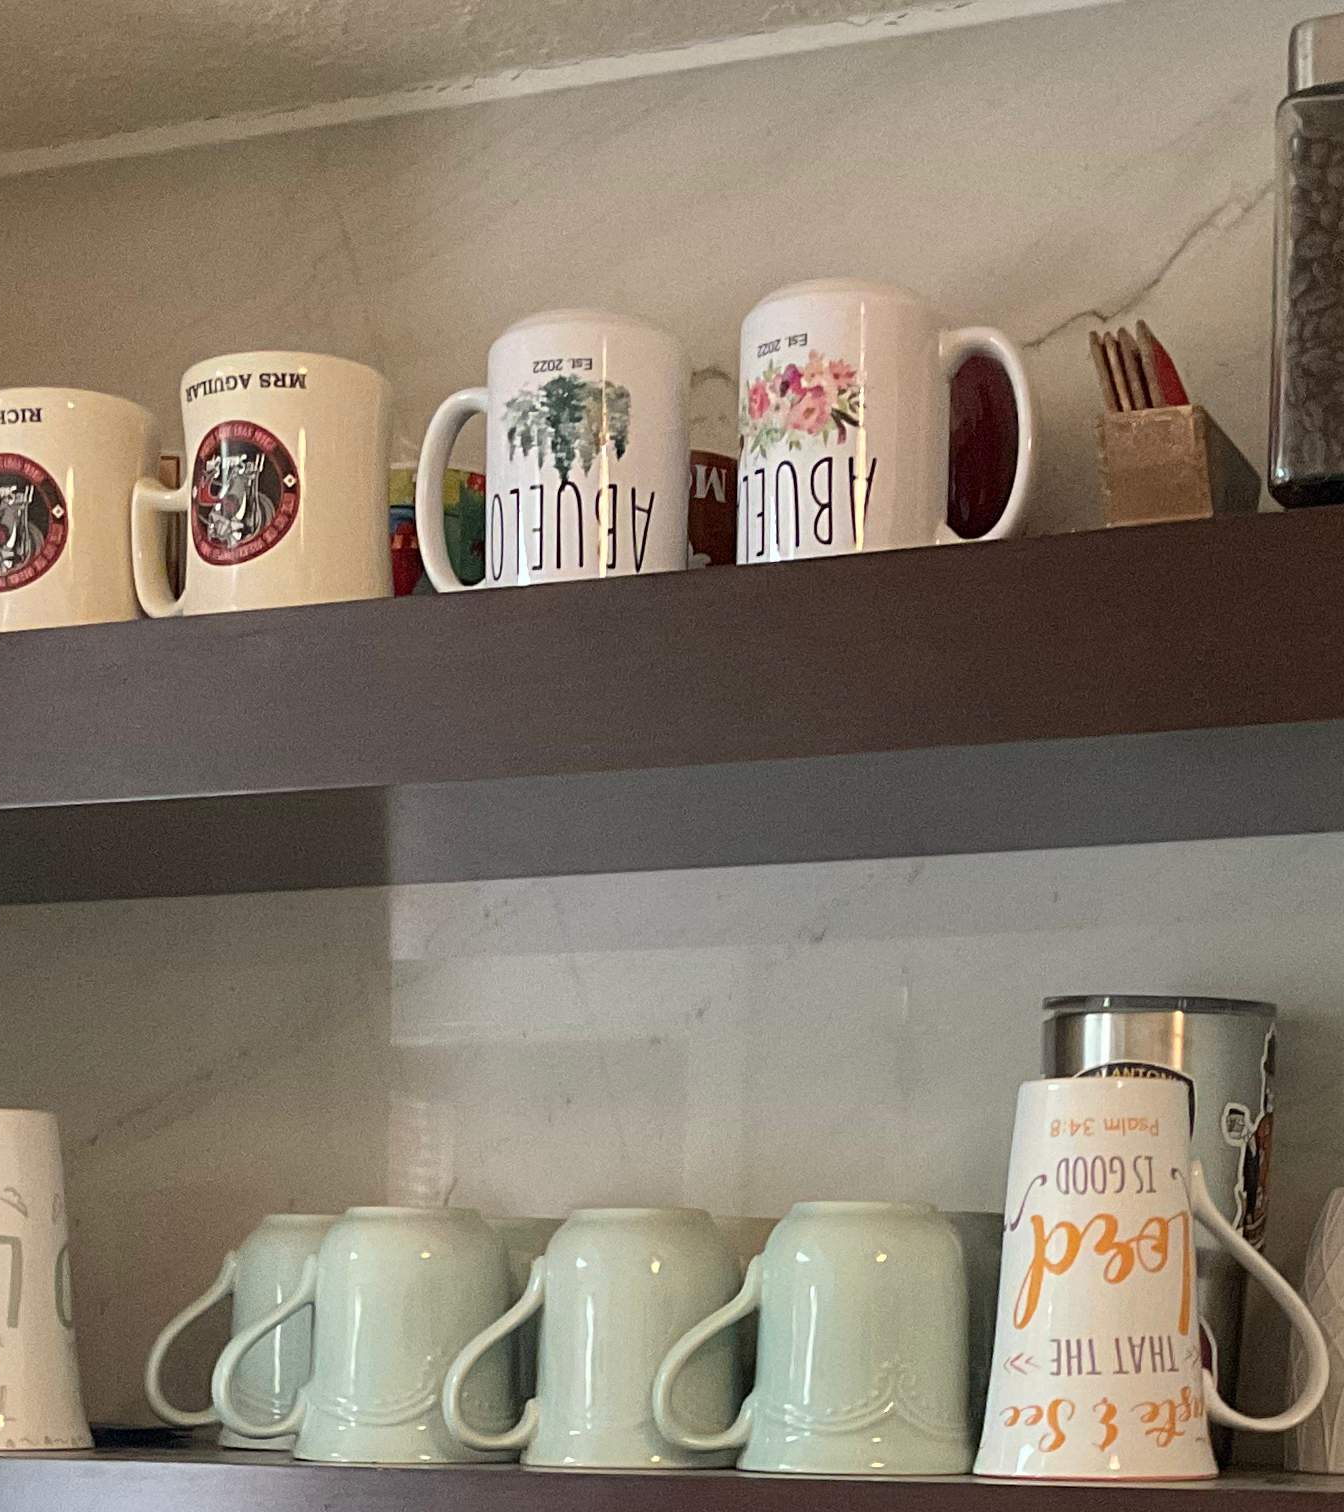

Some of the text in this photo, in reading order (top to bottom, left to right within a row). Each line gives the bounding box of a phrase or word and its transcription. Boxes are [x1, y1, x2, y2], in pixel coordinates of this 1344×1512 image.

[532, 357, 593, 374] Est. 2022
[185, 372, 308, 403] MRS AGUILAR
[737, 456, 877, 564] ABUEL
[491, 481, 657, 582] ABUELO
[1050, 1117, 1160, 1138] Psalm 34:8
[1056, 1155, 1158, 1195] IS GOOD
[1049, 1335, 1180, 1377] THAT THE
[999, 1397, 1076, 1453] See
[1091, 1396, 1120, 1452] &
